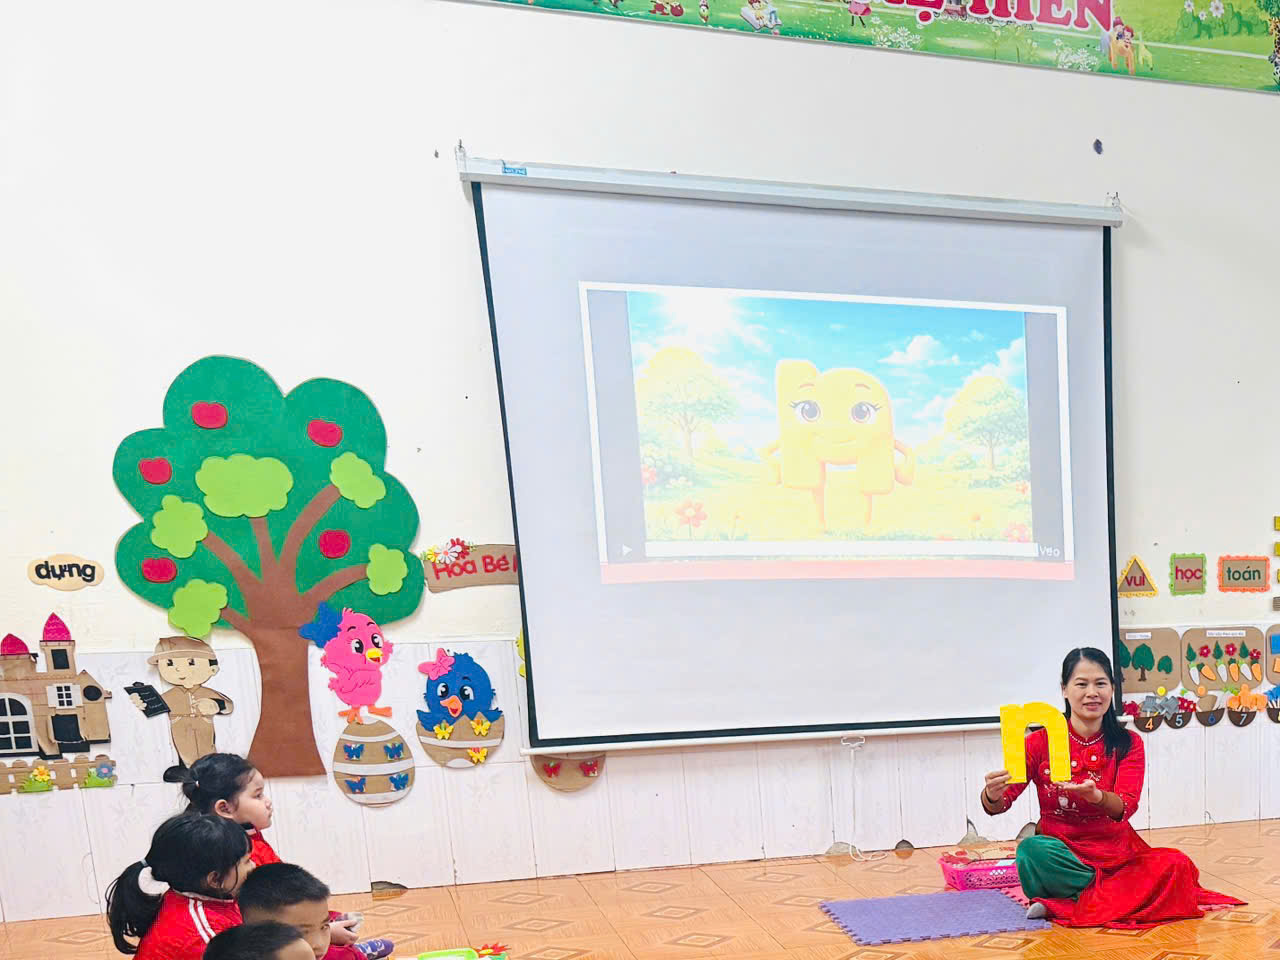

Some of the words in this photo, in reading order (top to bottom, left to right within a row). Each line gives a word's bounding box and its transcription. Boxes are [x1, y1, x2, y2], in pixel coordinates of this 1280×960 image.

[1040, 545, 1061, 558] Veo
[432, 560, 477, 580] Hoa
[1175, 566, 1203, 583] học
[1226, 566, 1261, 581] toán
[1125, 575, 1146, 588] vui
[1145, 718, 1153, 730] 4
[1175, 714, 1183, 727] 5
[1239, 713, 1247, 726] 7
[1000, 702, 1072, 785] n
